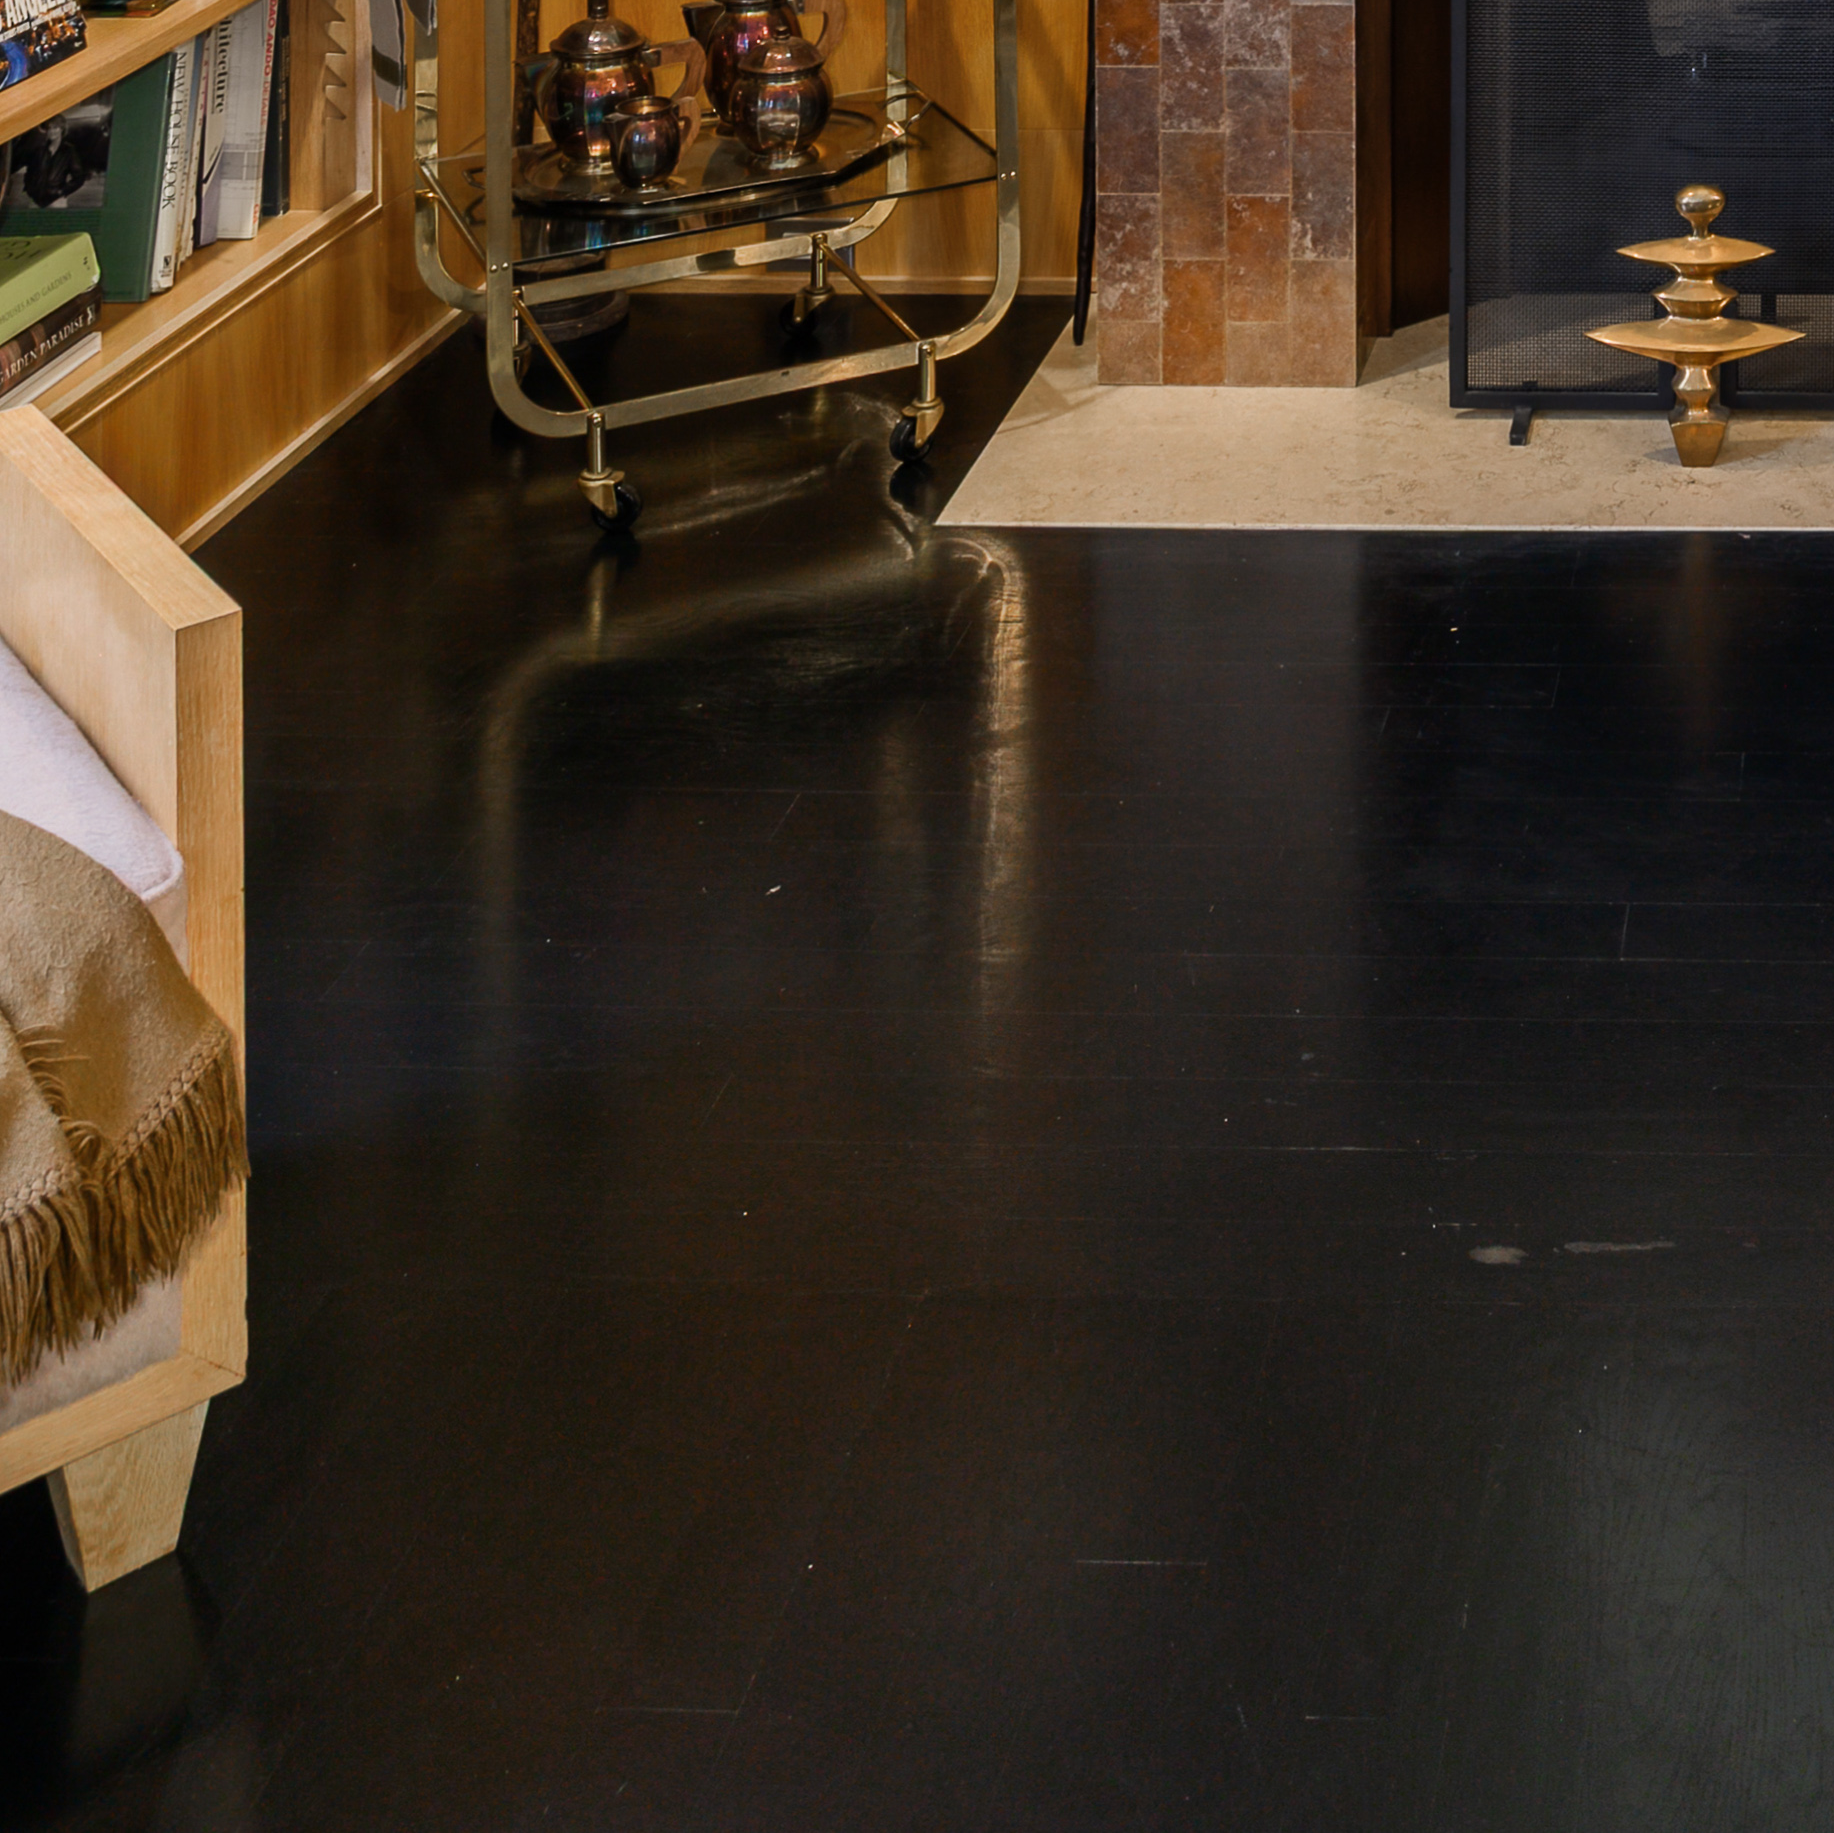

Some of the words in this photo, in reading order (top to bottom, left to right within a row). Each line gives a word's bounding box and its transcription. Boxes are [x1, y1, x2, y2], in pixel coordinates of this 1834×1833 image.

[171, 50, 187, 93] NEW
[207, 19, 234, 113] hitecture
[263, 32, 274, 77] ANDO
[259, 80, 270, 126] DETAILS
[166, 99, 183, 155] HOUSE
[161, 160, 178, 211] BOOK
[252, 203, 260, 224] GA
[25, 290, 42, 307] AND
[40, 271, 73, 298] GARDENS
[38, 314, 85, 357] PARADISE
